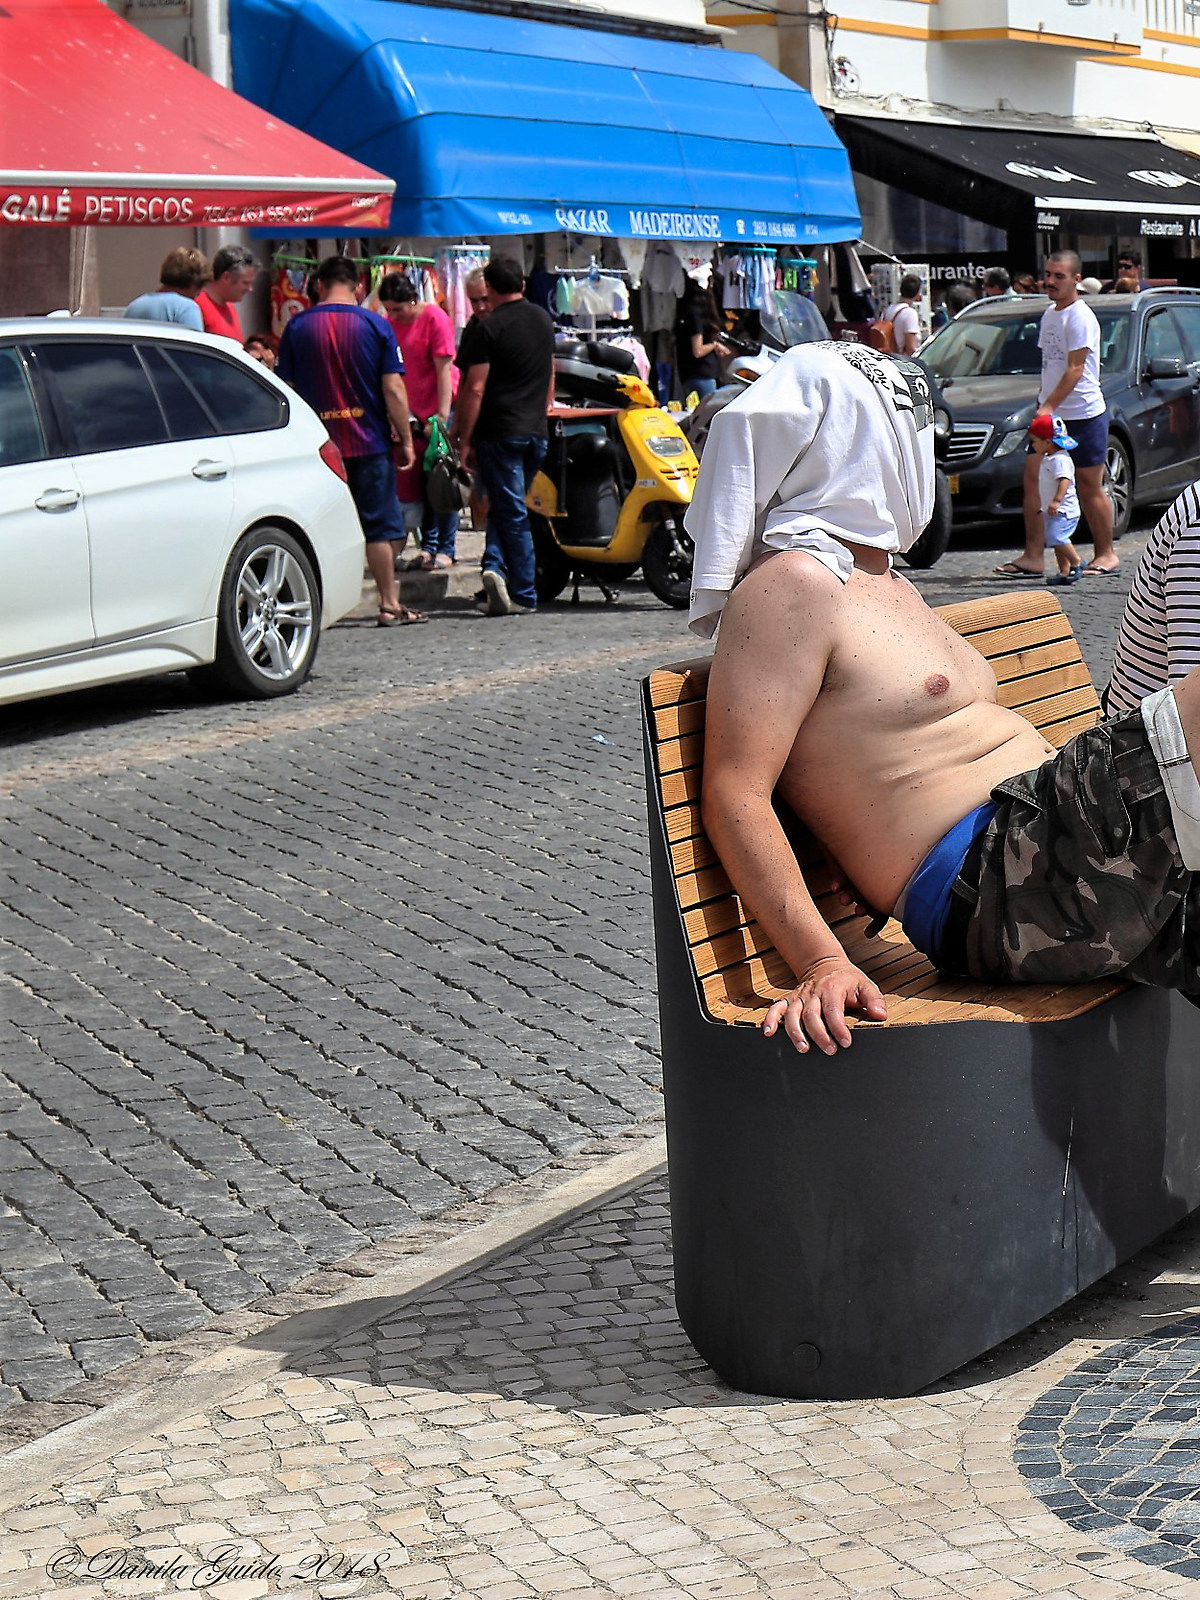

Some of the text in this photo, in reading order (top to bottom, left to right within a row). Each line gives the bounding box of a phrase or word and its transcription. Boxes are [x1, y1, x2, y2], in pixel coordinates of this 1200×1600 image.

[1, 188, 71, 222] GALÉ
[83, 196, 194, 223] PETISCOS
[555, 208, 613, 234] BAZAR
[629, 210, 722, 238] MADEIRENSE
[1140, 219, 1184, 236] Restaurante
[1189, 219, 1197, 236] A
[927, 262, 986, 280] urante
